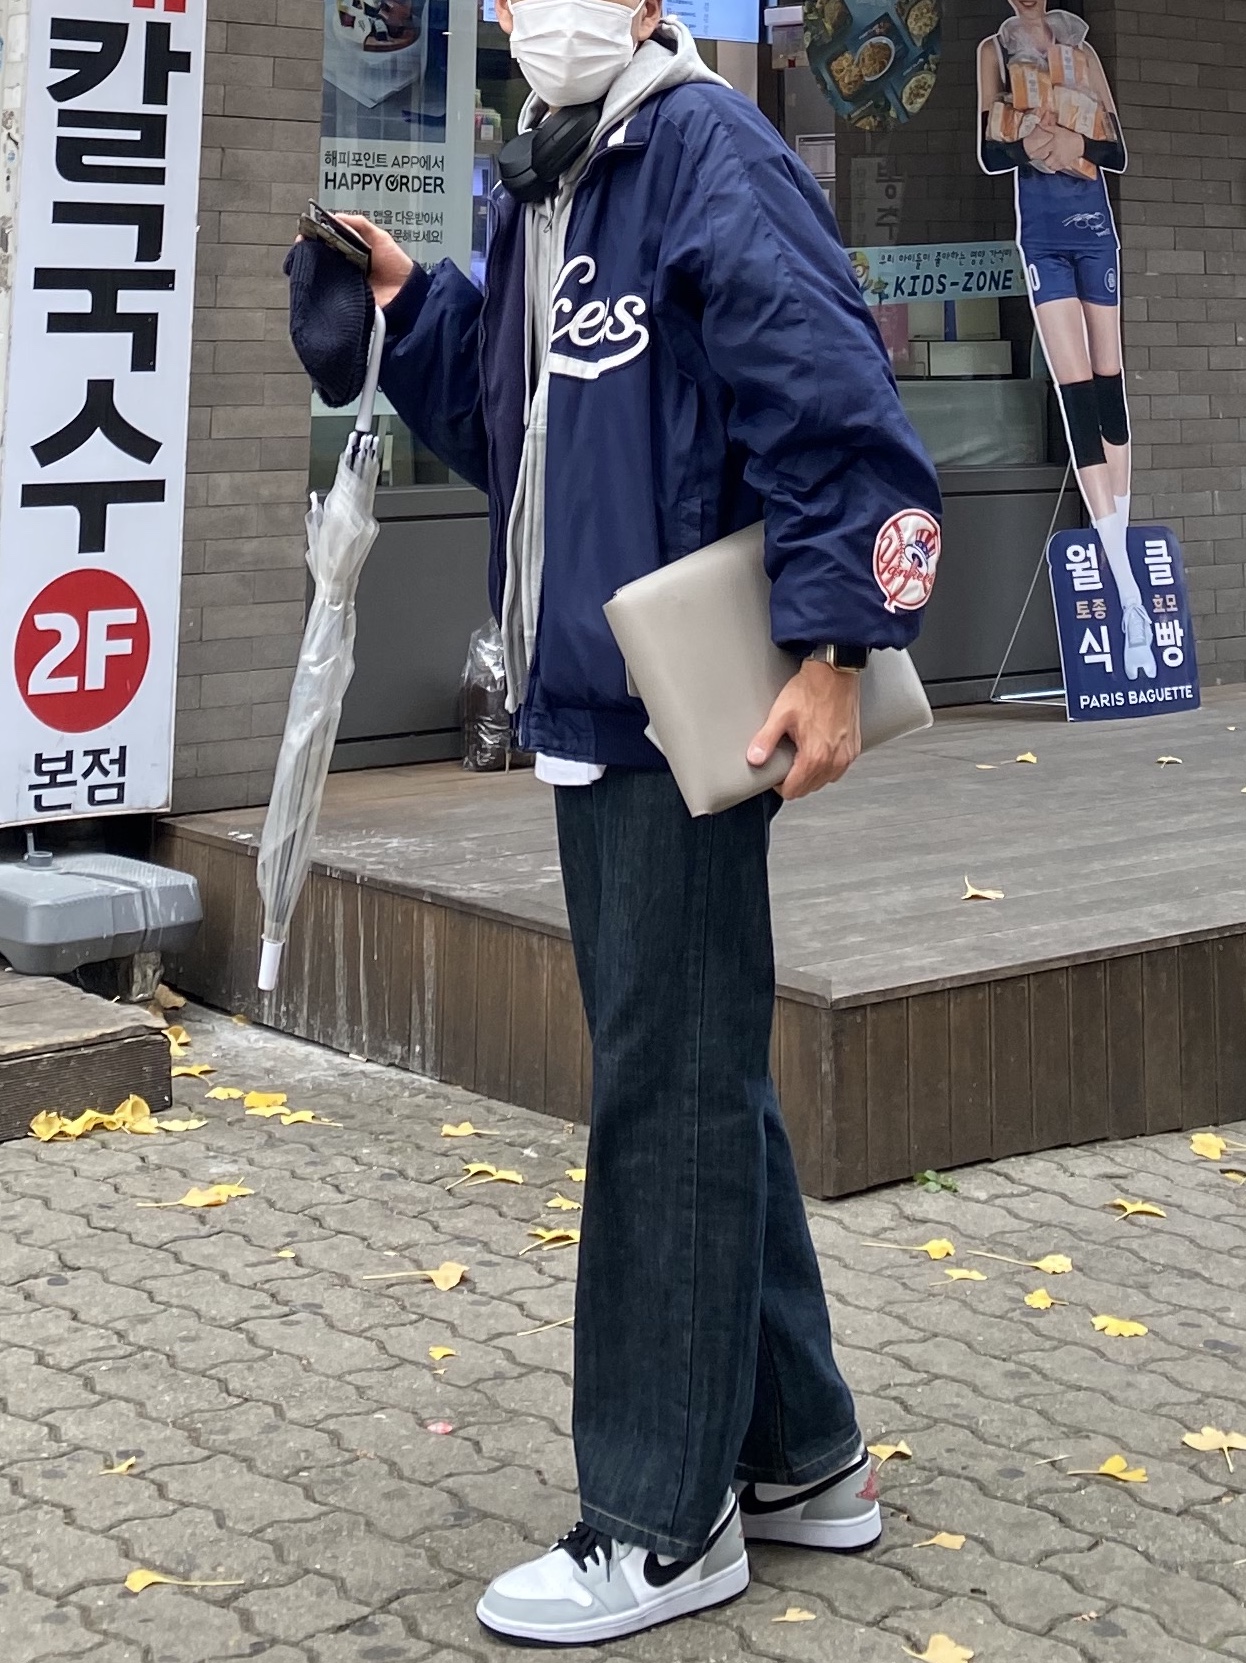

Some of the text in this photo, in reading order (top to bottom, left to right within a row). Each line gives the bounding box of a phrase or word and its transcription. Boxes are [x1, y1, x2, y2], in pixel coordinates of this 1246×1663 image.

[324, 150, 445, 172] 해피포인트 APP에서
[324, 171, 446, 194] HAPPY ORDER
[373, 210, 393, 225] 앱을
[395, 210, 444, 226] 다운받아서
[20, 17, 192, 554] 칼국수
[893, 269, 1014, 298] KIDS-ZONE
[1065, 539, 1174, 592] 월 클
[1075, 598, 1107, 619] 토종
[27, 607, 138, 696] 2F
[1079, 619, 1184, 673] 식 빵
[1079, 684, 1194, 709] PARIS BAGUETTE
[28, 745, 128, 812] 본점
